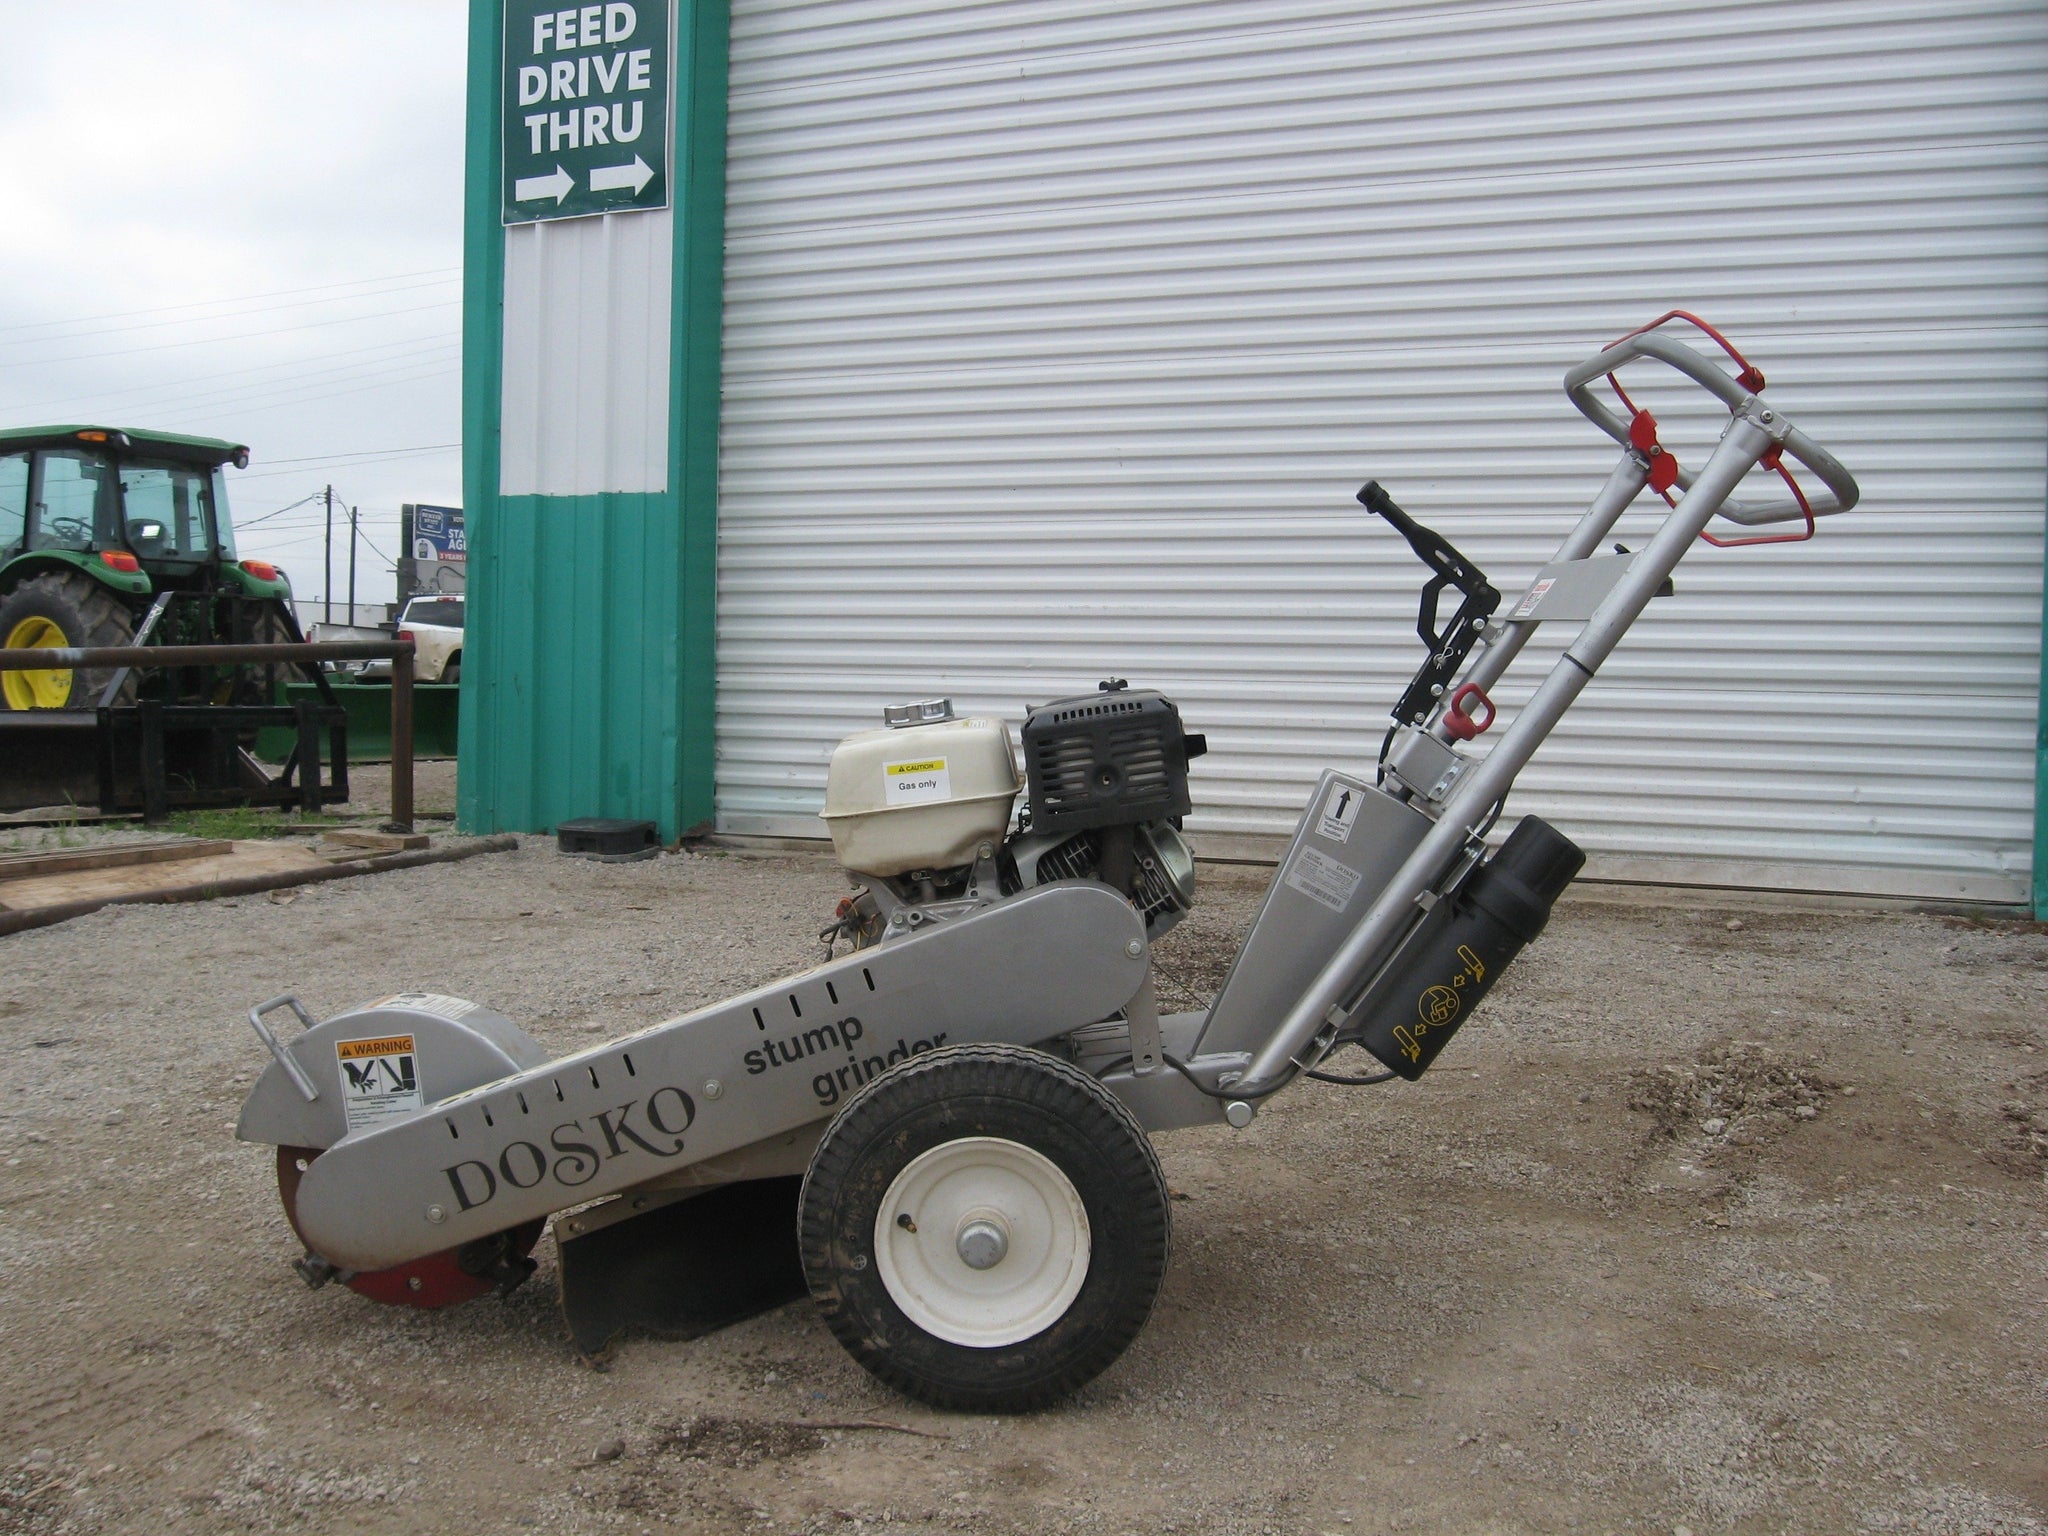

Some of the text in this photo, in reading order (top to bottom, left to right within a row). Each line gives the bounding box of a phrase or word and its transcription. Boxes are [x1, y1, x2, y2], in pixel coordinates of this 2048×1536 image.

[533, 2, 637, 54] FEED
[519, 48, 651, 107] DRIVE
[524, 101, 643, 155] THRU
[898, 779, 936, 790] Gas only
[906, 763, 934, 771] CAUTION
[354, 1040, 411, 1054] WARNING
[742, 1015, 864, 1075] stump
[812, 1031, 948, 1107] grinder
[441, 1086, 697, 1212] DOSKO
